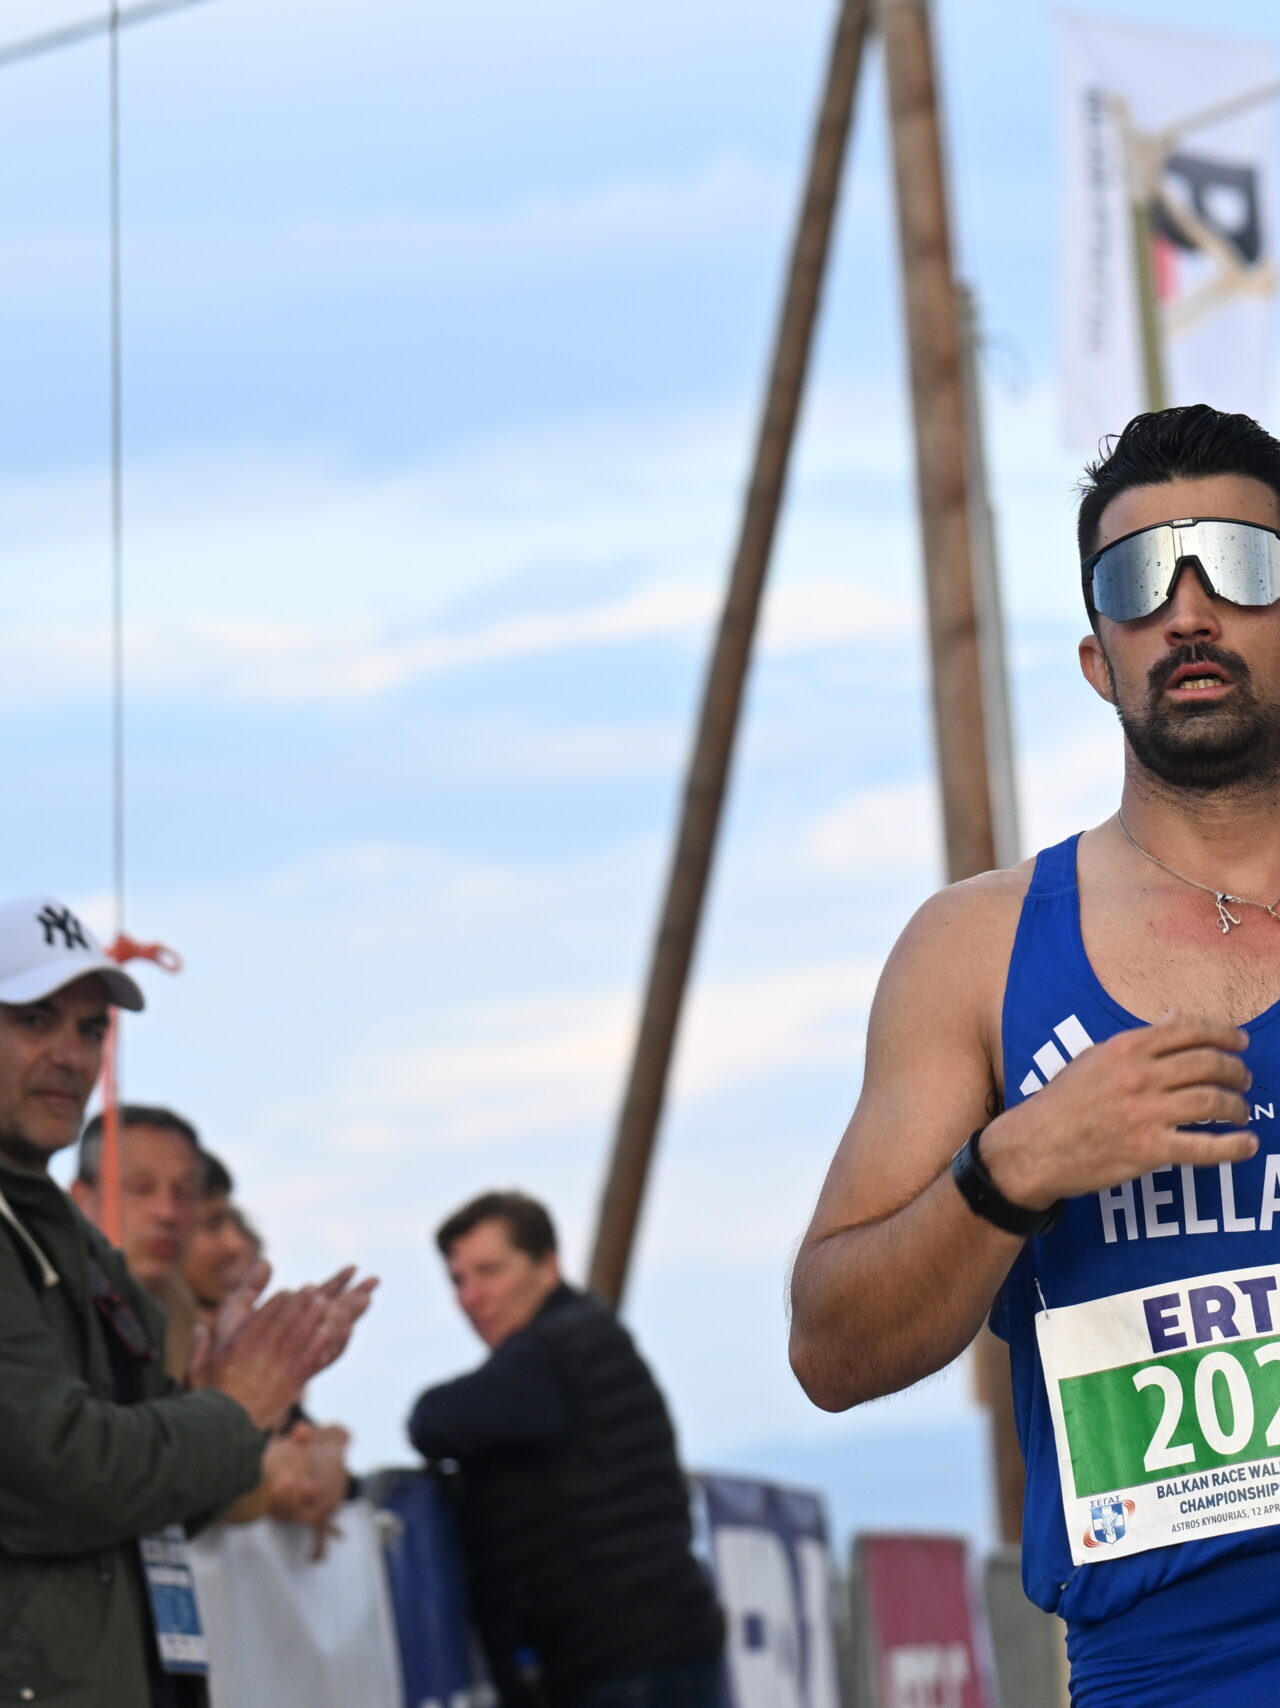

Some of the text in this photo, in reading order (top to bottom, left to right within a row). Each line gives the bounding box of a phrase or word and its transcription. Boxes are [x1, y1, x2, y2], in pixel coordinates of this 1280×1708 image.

[36, 904, 90, 950] NY
[1143, 1276, 1277, 1354] ERT
[1156, 1474, 1209, 1499] BALKAN
[1212, 1468, 1247, 1486] RACE
[1089, 1495, 1121, 1507] ΣΕΓΑΣ
[1171, 1520, 1201, 1533] ASTROS
[1201, 1509, 1250, 1527] KYNOURIAS,
[1252, 1507, 1262, 1517] 12
